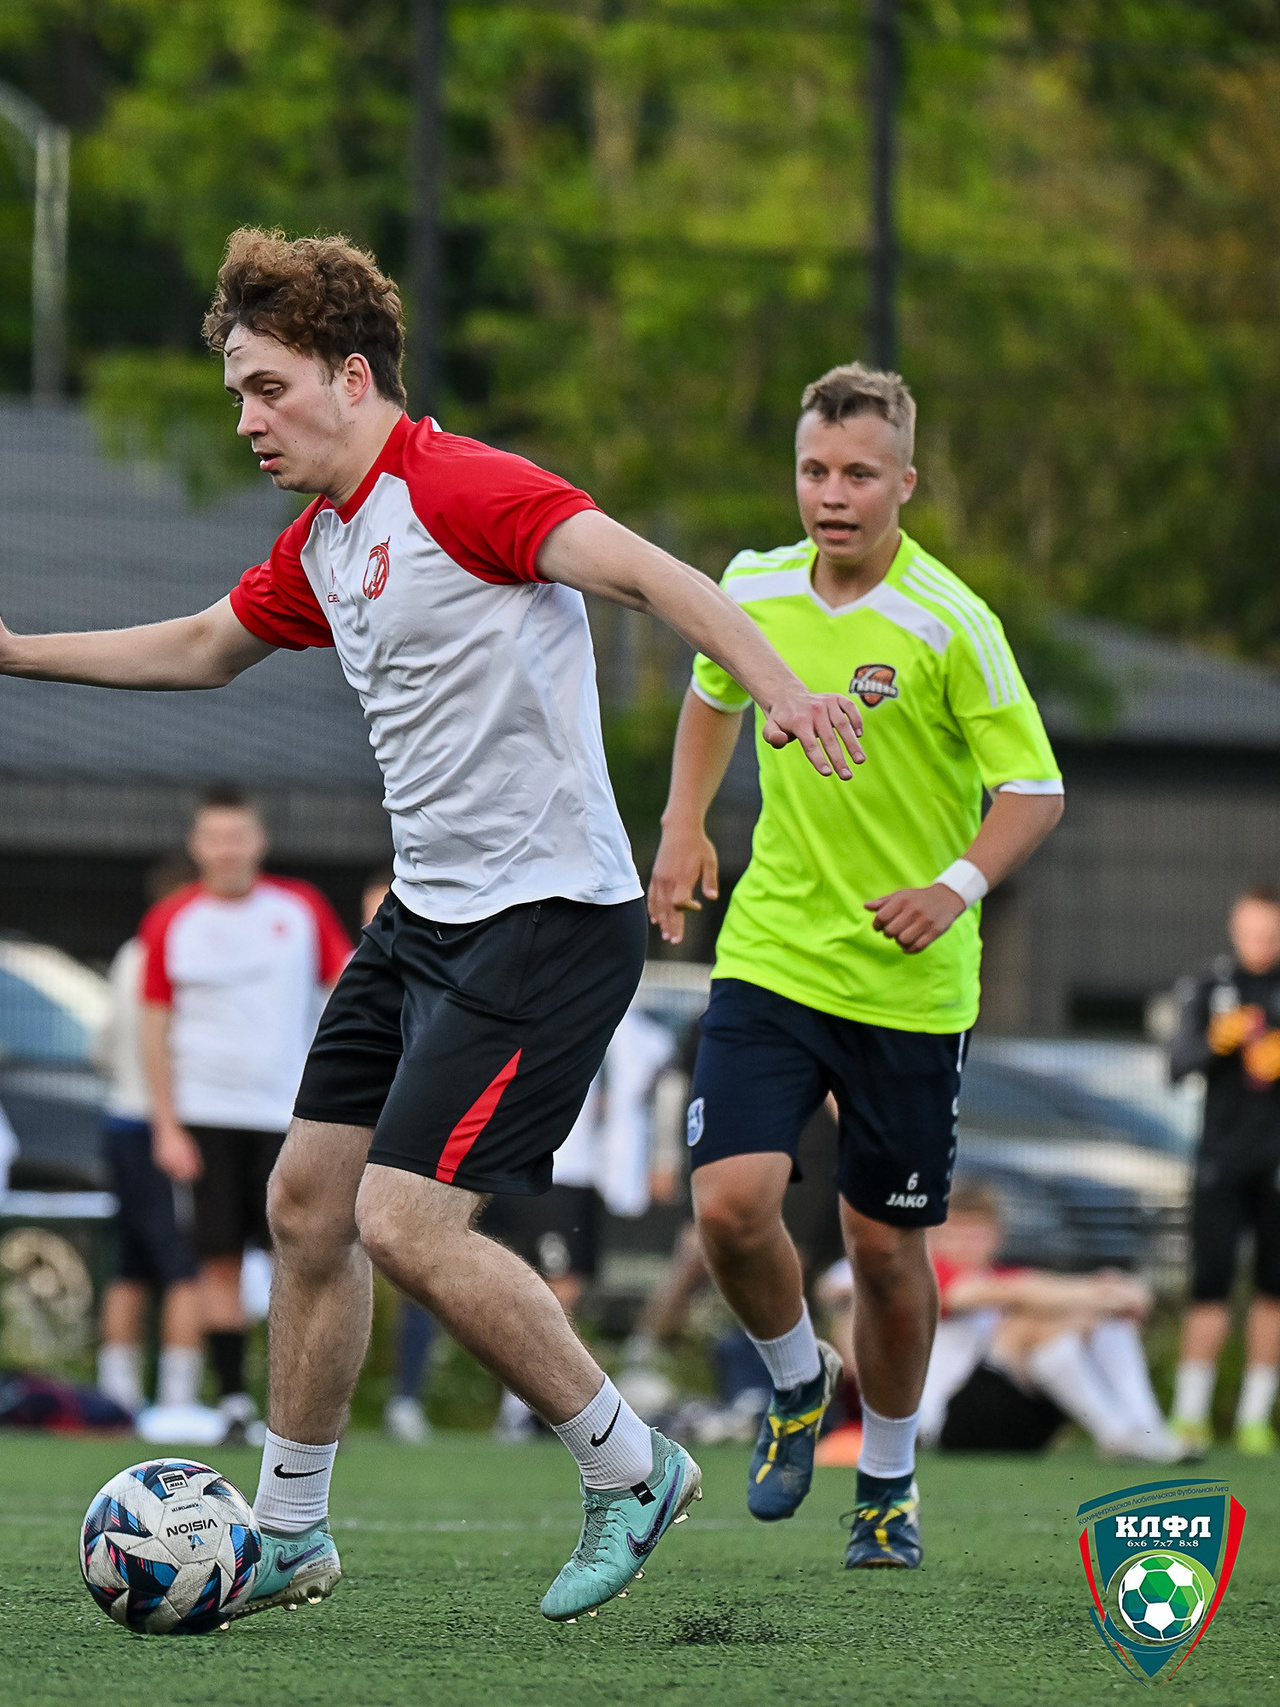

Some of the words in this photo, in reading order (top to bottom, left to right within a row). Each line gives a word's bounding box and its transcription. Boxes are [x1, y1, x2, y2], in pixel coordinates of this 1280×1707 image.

[907, 1172, 919, 1191] 6
[885, 1193, 928, 1208] JAKO
[166, 1518, 218, 1538] VISION
